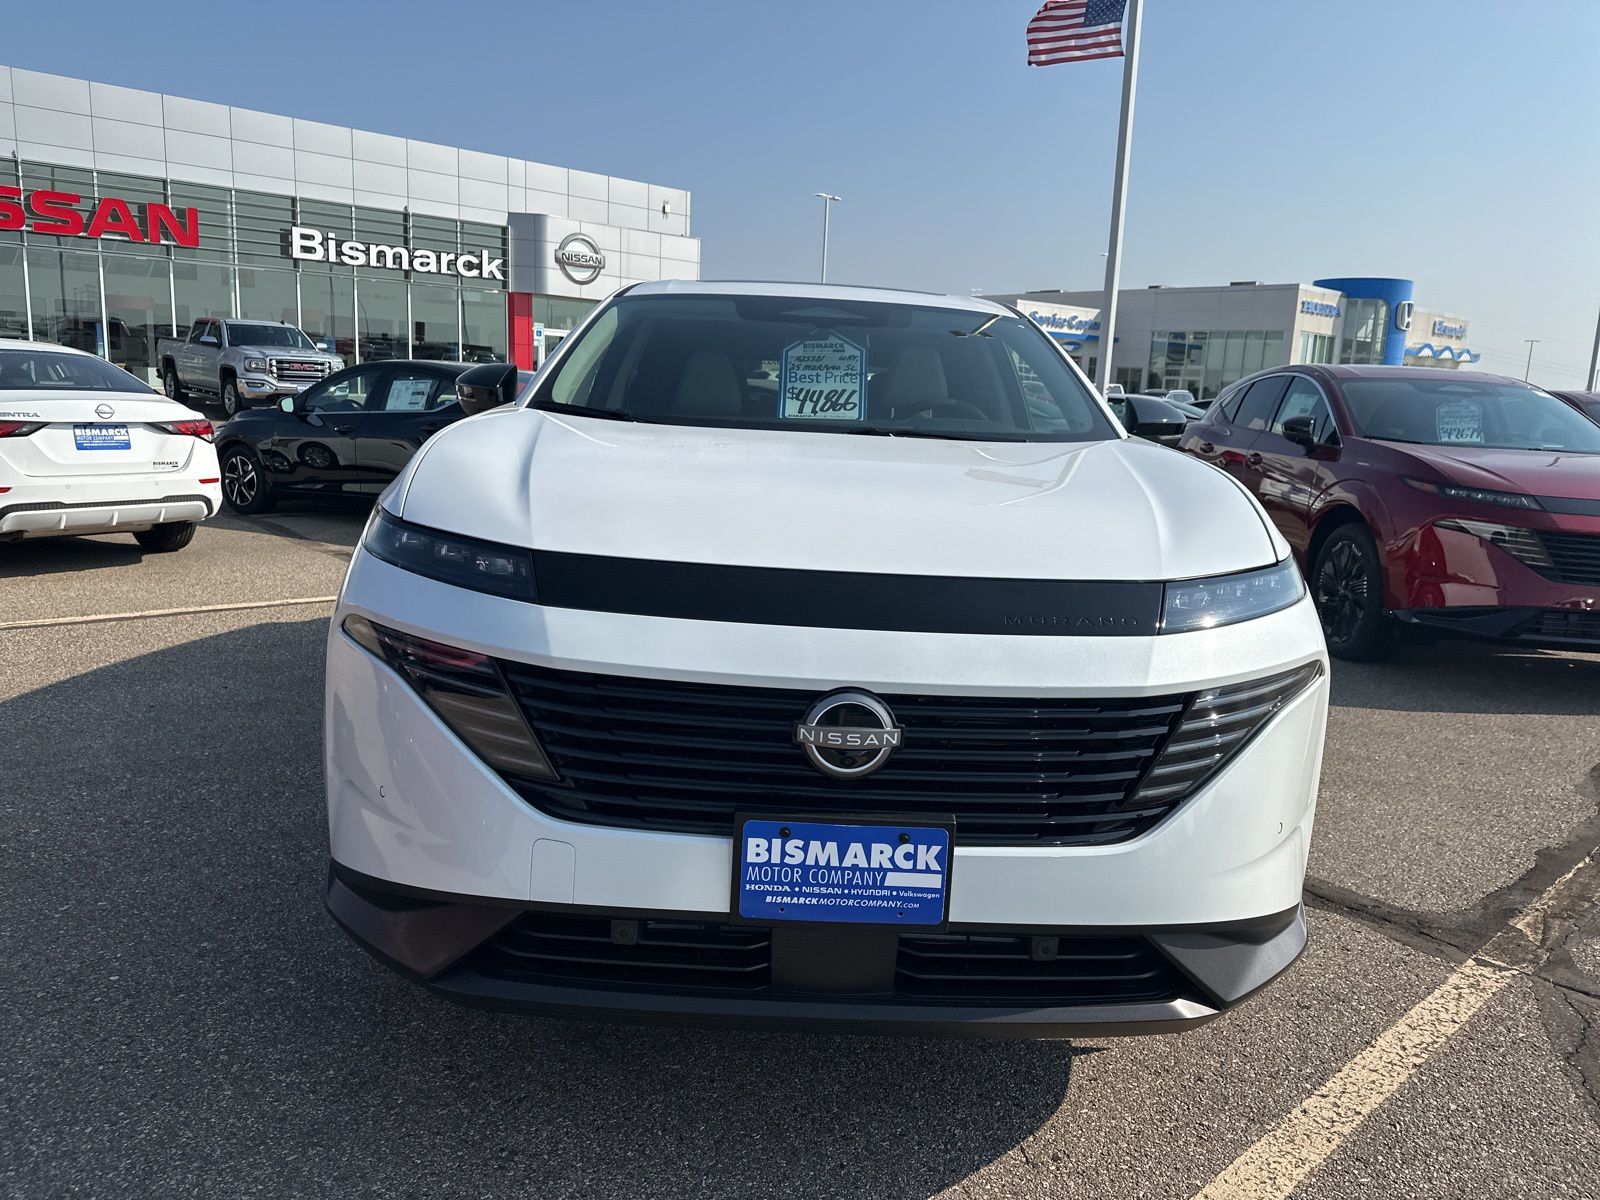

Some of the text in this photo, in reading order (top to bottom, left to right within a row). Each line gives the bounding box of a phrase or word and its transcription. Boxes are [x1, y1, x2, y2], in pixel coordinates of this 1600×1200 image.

[291, 226, 504, 280] Bismarck
[561, 252, 602, 266] NISSAN
[1029, 310, 1101, 331] Service Cente
[289, 363, 315, 371] GMC
[788, 371, 858, 384] Best Price
[787, 385, 858, 416] $44,866
[75, 428, 128, 436] BISMARCK
[1003, 615, 1138, 626] MURANO
[800, 728, 898, 746] NISSAN
[746, 838, 943, 871] BISMARCK
[746, 866, 884, 886] MOTOR COMPANY
[745, 883, 940, 899] HONDA NISSAN HYUNDAI Volkswagen
[765, 895, 920, 909] BISMARCKMOTORCOMPANY.COM
